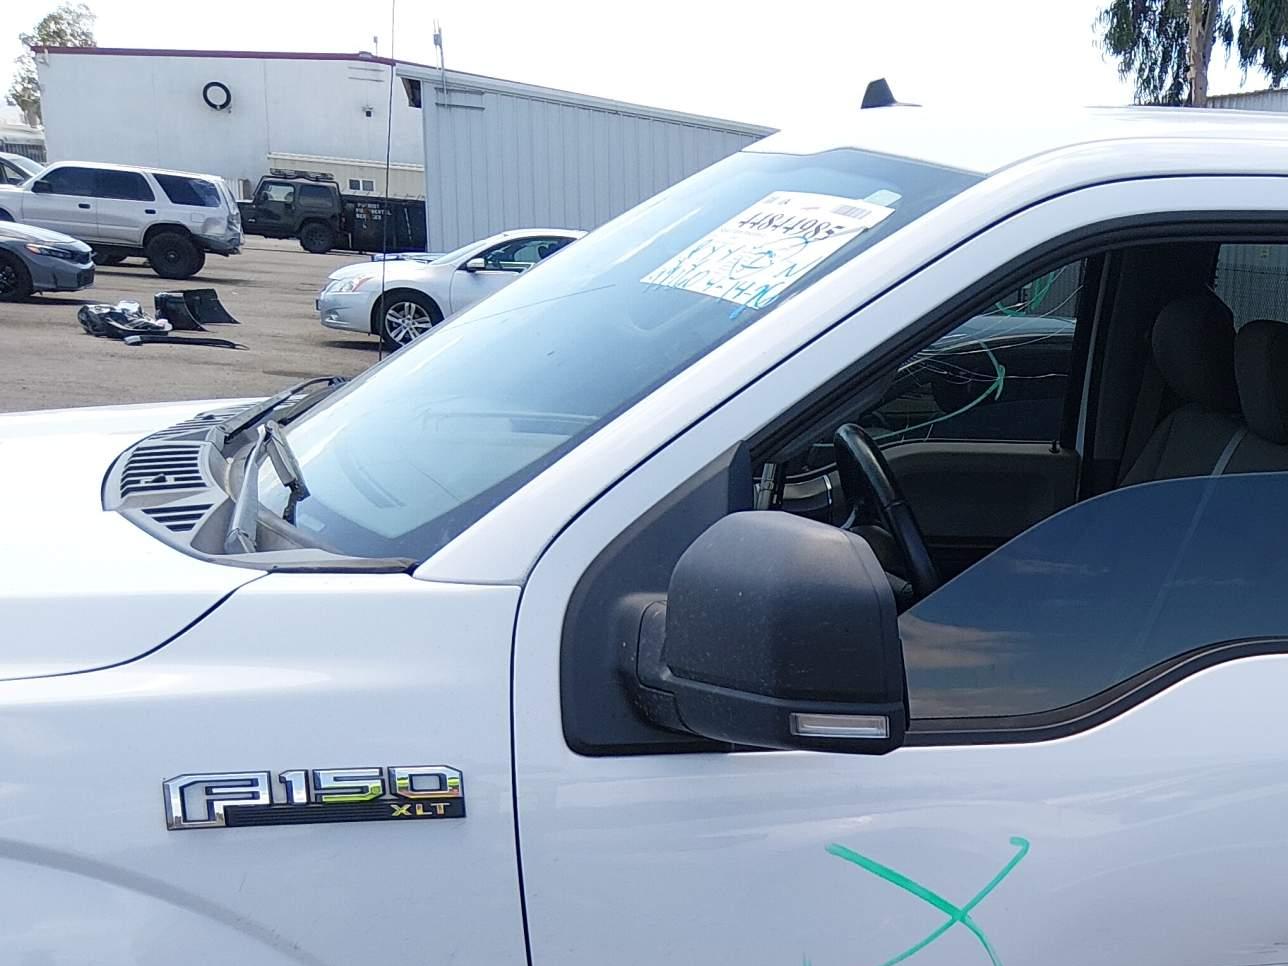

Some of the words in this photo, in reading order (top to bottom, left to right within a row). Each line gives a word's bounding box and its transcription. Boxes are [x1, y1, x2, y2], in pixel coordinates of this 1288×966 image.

[738, 212, 845, 240] 44844985
[162, 764, 464, 830] F150
[390, 802, 451, 817] XLT
